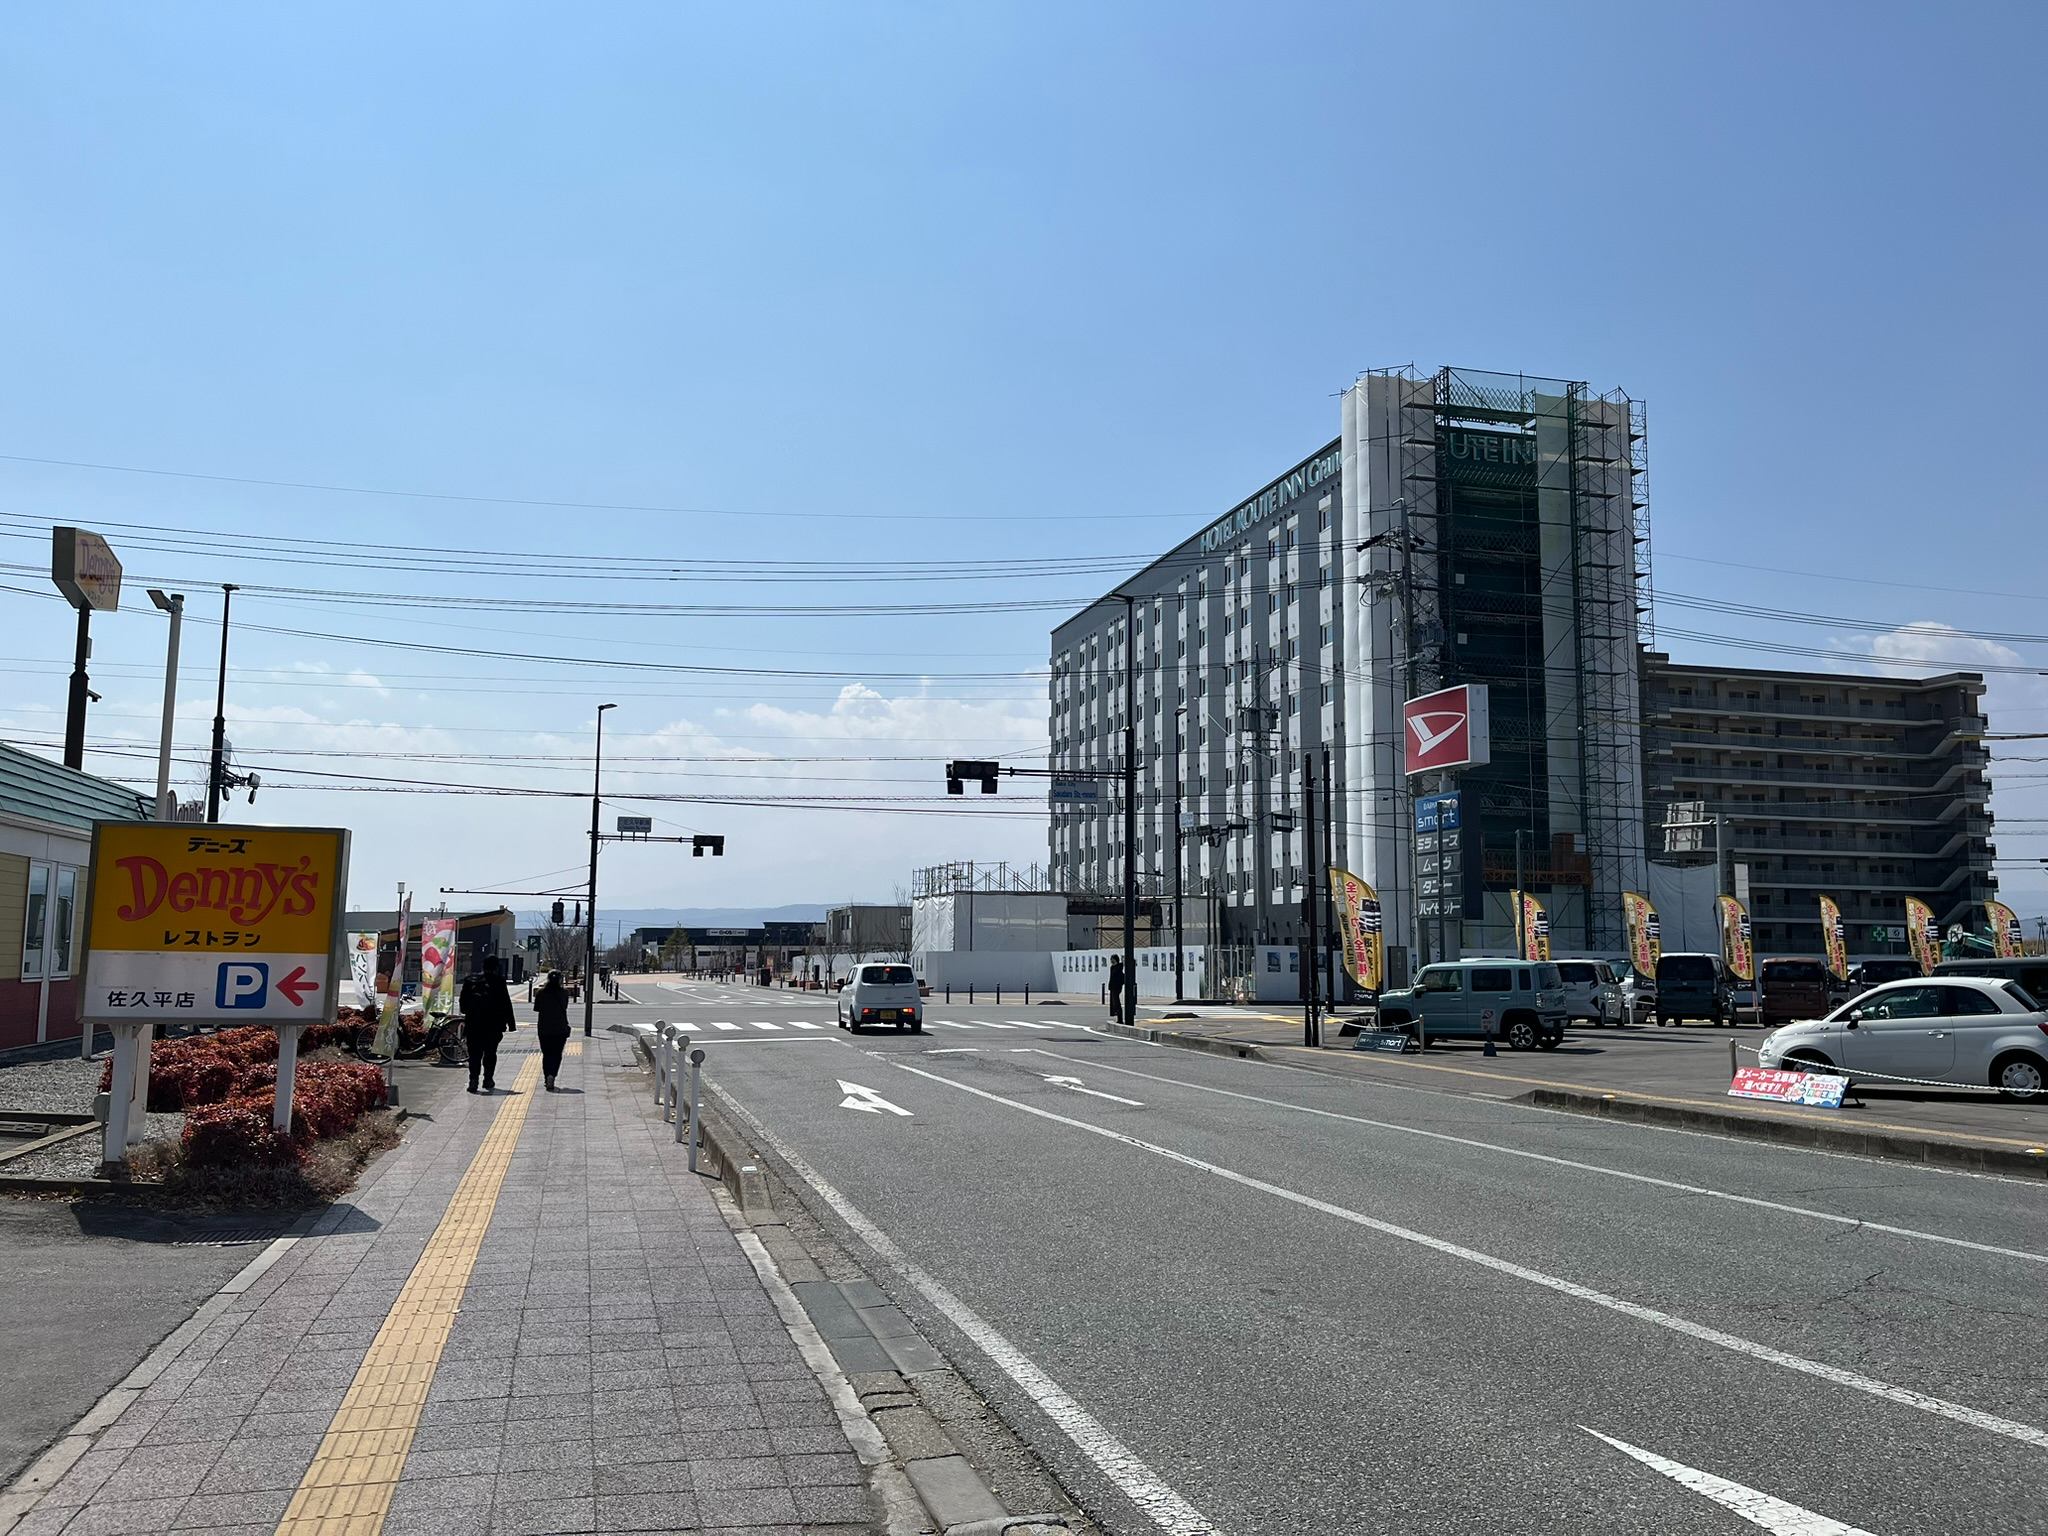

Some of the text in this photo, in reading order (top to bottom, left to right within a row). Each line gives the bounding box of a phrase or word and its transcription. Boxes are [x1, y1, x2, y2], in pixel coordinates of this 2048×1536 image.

[1200, 451, 1342, 558] HOTEL ROUTE INN Gran
[187, 837, 253, 854] デニーズ
[115, 855, 319, 926] Denny's
[164, 930, 261, 946] レストラン
[107, 991, 196, 1008] 佐久平店
[224, 966, 264, 1006] P
